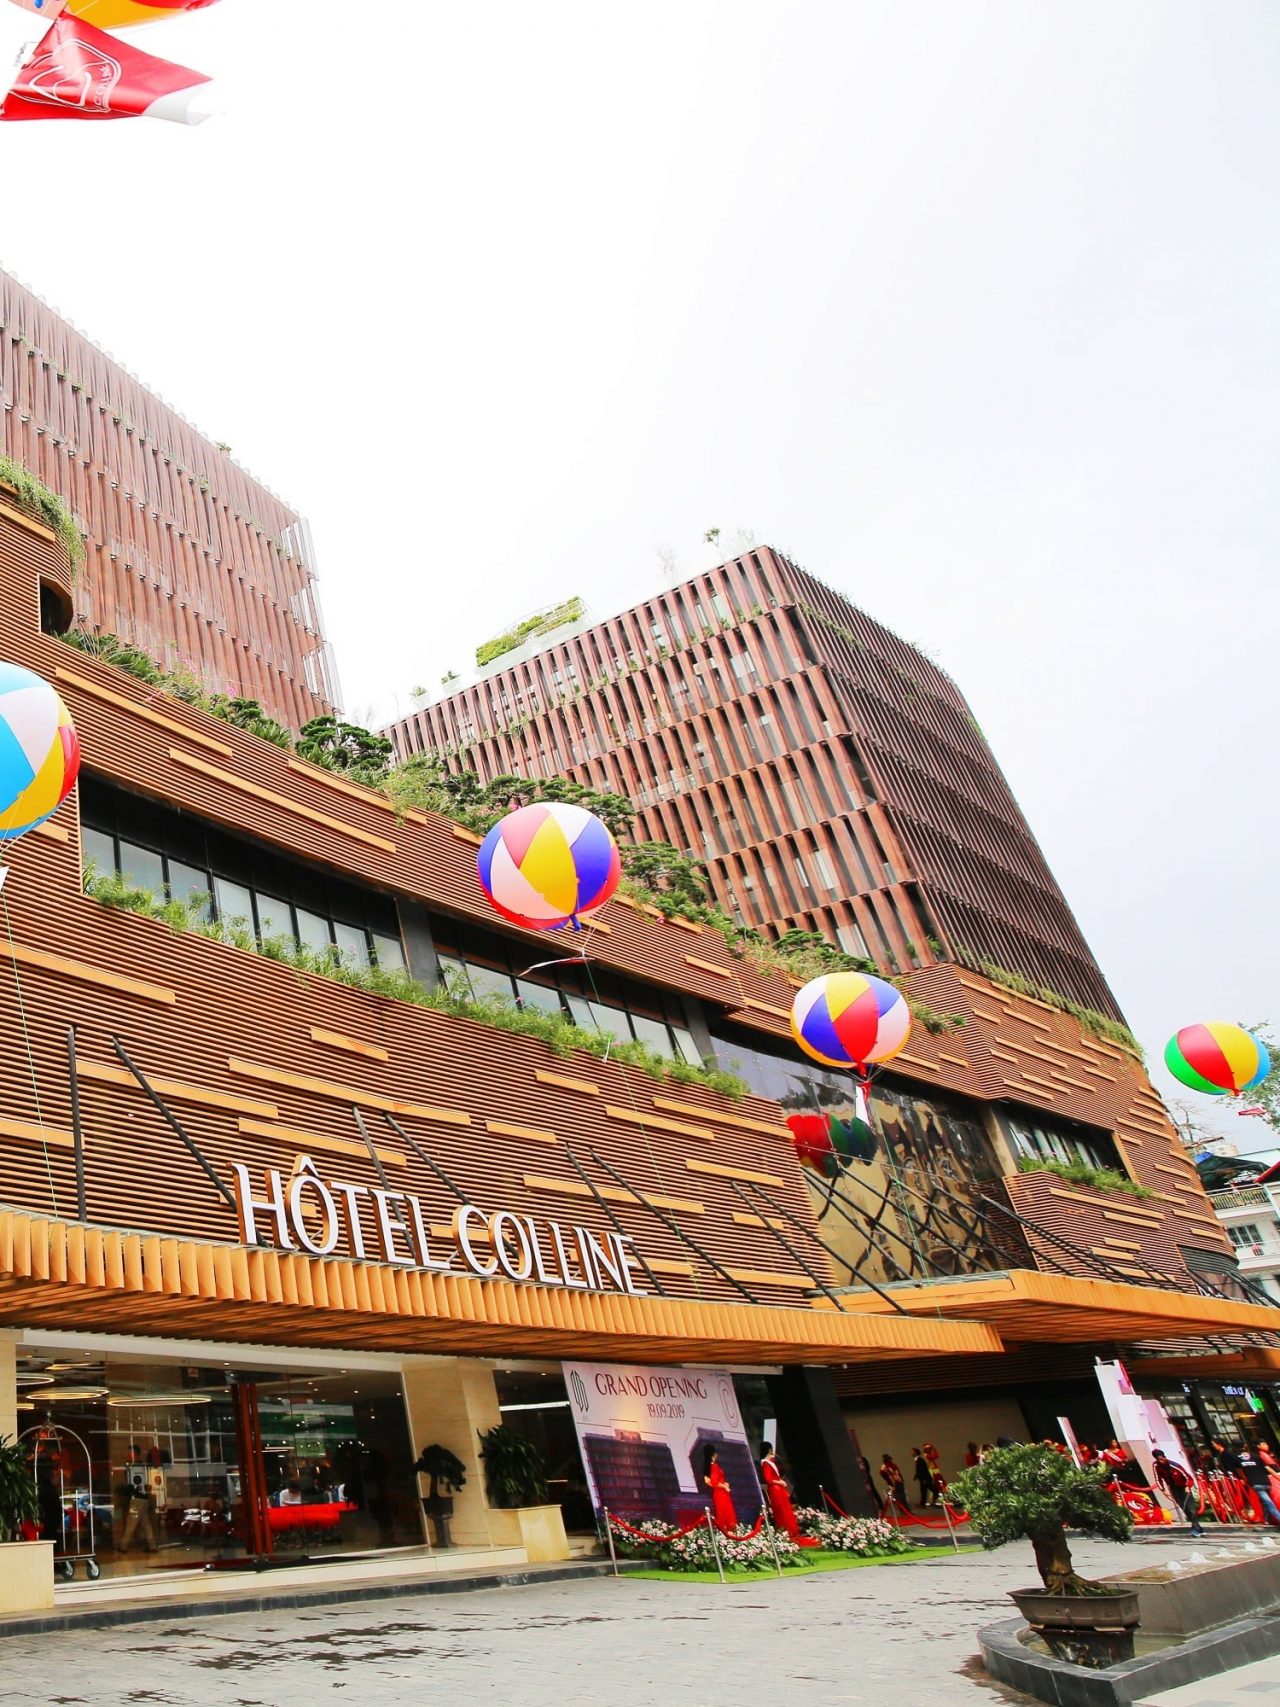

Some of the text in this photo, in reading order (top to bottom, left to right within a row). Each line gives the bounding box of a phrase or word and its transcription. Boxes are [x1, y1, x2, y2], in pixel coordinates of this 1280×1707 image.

[227, 1153, 648, 1296] HÔTEL COLLINE
[594, 1372, 708, 1400] GRAND OPENING
[646, 1403, 686, 1419] 19.09.2019
